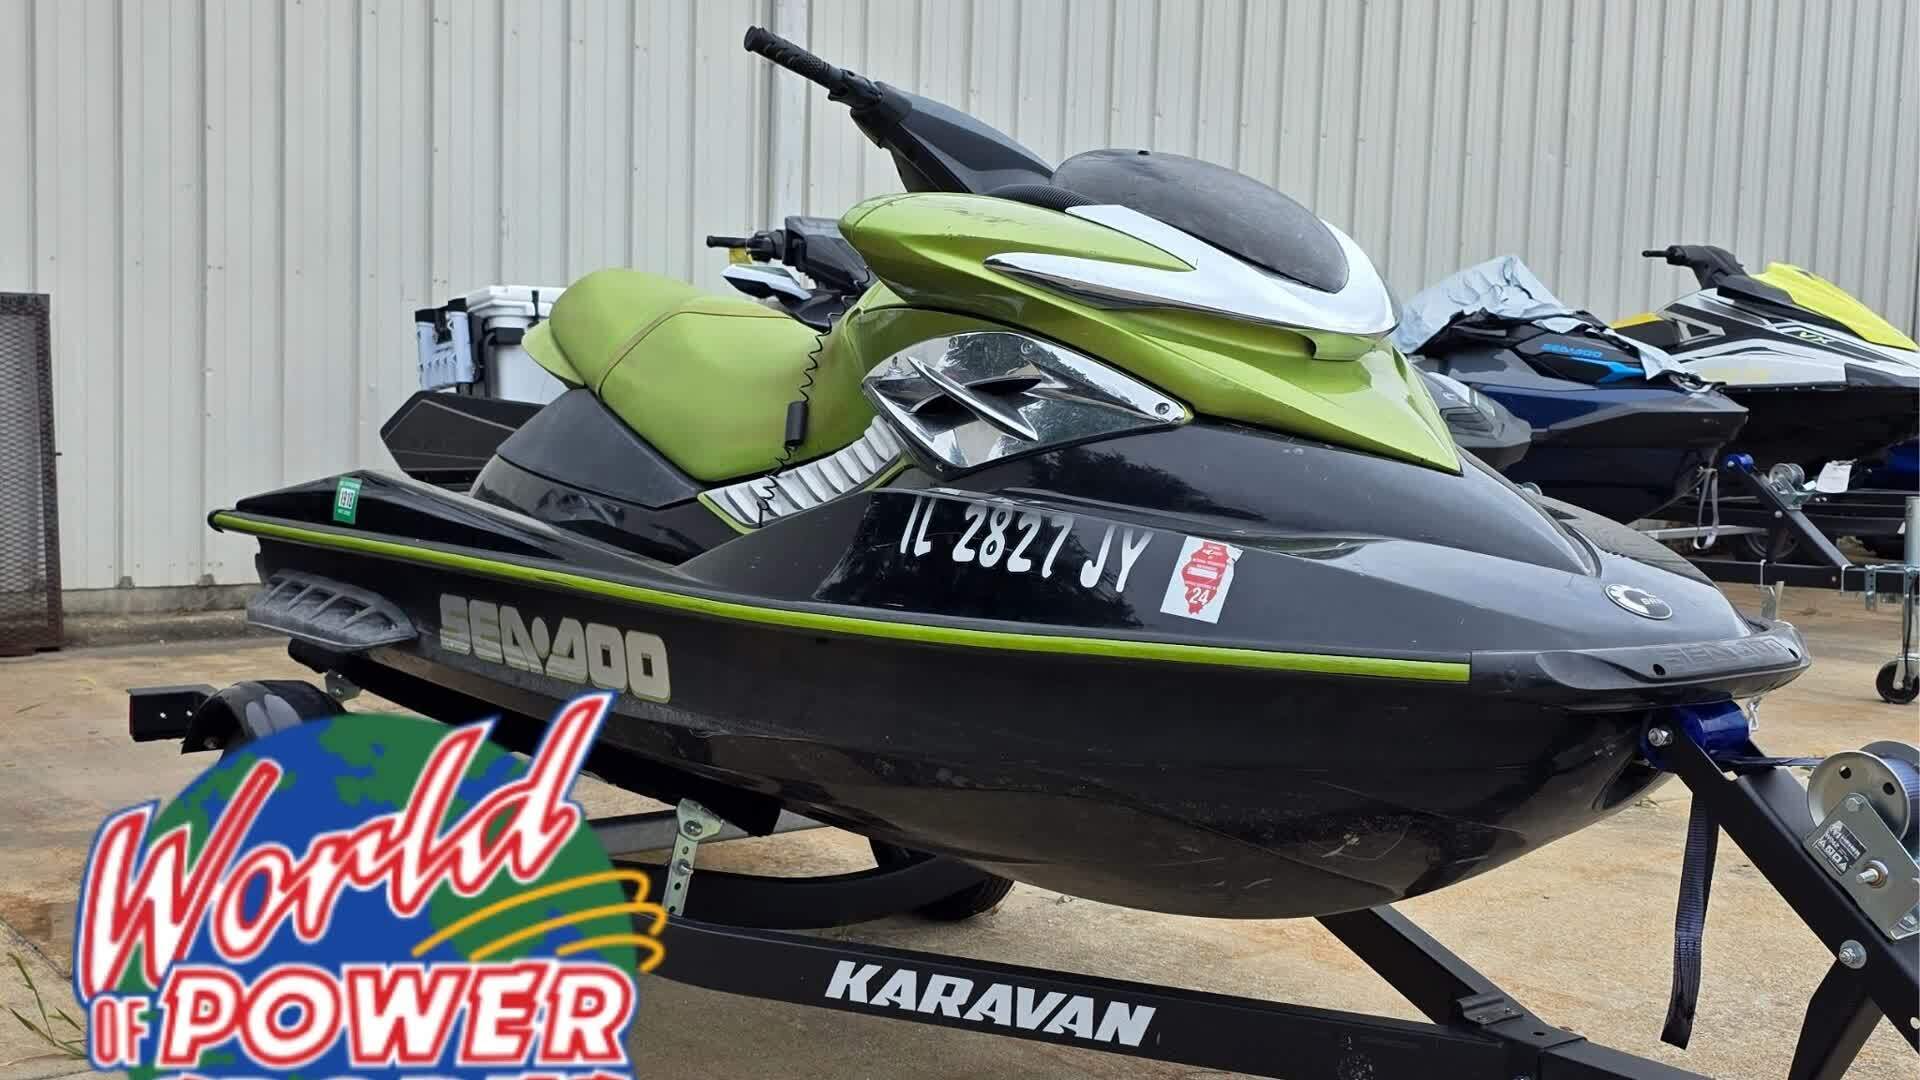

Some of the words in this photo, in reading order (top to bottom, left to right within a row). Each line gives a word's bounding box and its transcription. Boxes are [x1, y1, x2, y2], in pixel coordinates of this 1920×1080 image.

[900, 496, 937, 557] IL
[952, 503, 1074, 578] 2827
[1080, 524, 1155, 593] JY
[1189, 587, 1211, 606] 24
[824, 960, 1157, 1048] KARAVAN
